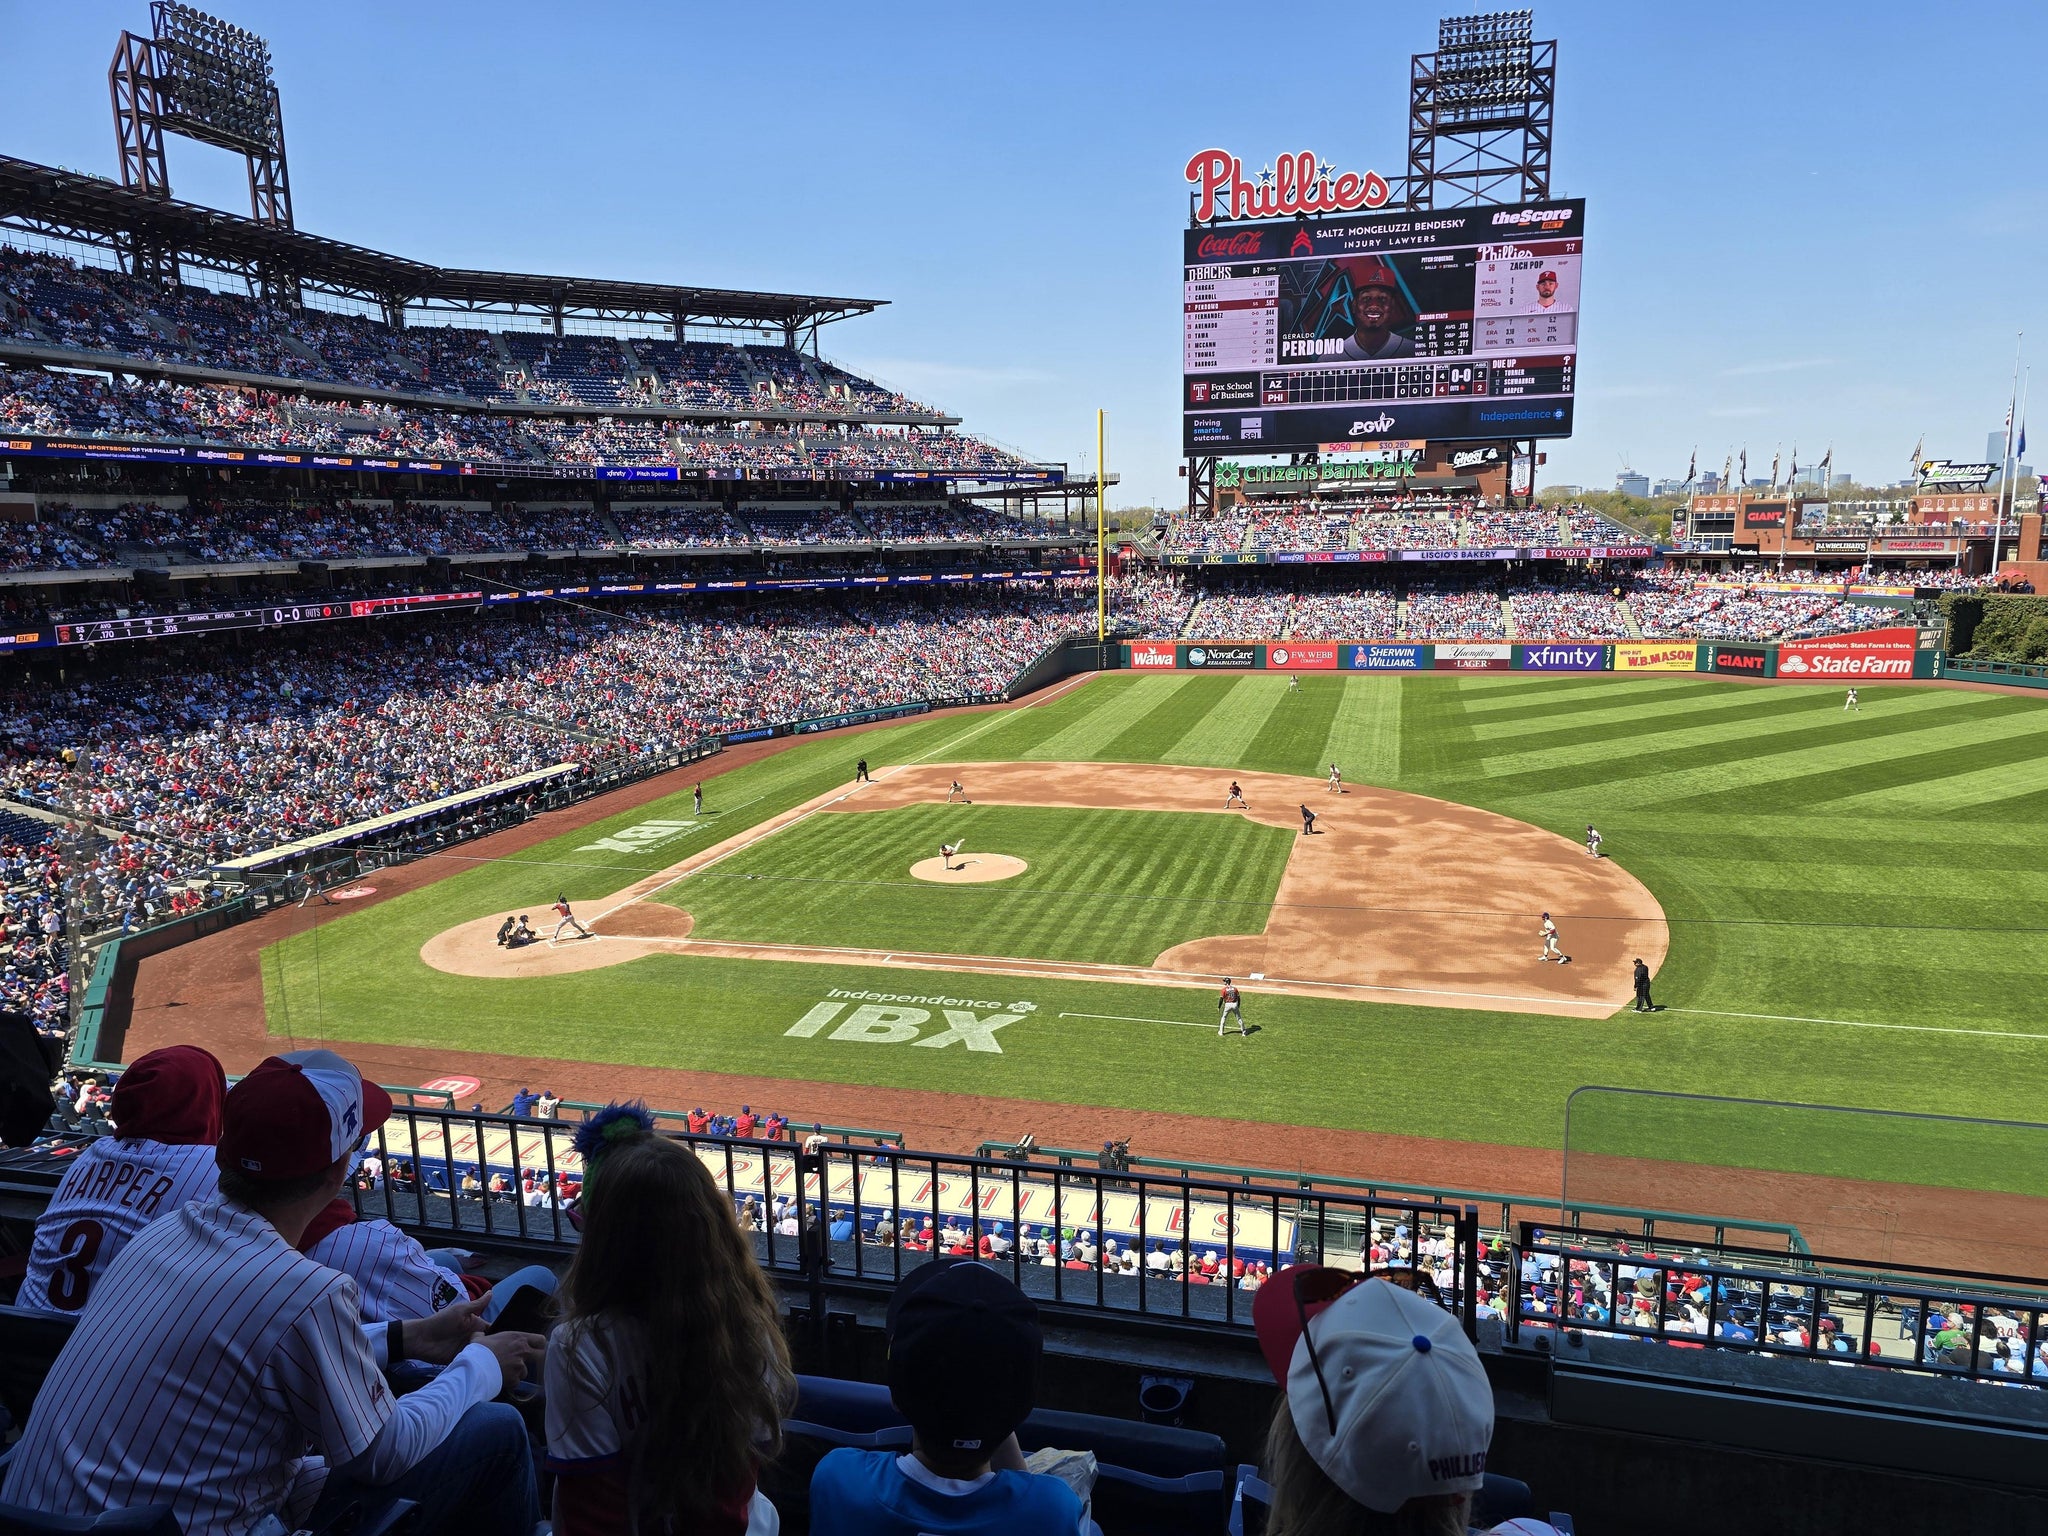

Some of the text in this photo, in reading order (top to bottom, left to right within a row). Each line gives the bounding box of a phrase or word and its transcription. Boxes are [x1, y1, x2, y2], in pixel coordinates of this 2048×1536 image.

[1185, 148, 1390, 222] Phillies
[1492, 208, 1573, 225] theScore
[1316, 219, 1466, 239] SALTZ MONGELUZZI BENDESKY
[1344, 234, 1436, 249] INJURY LAWYERS
[1478, 245, 1533, 261] Phillies
[1510, 262, 1528, 270] ZACH
[1530, 261, 1543, 269] POP
[1282, 332, 1315, 340] GERALDO
[1282, 338, 1344, 357] PERDOMO
[1492, 359, 1517, 369] DUE UP
[1269, 380, 1282, 389] AZ
[1439, 372, 1445, 380] 4
[1451, 368, 1472, 383] 0-0
[1211, 381, 1252, 391] Fox School
[1210, 391, 1254, 400] of Business
[1267, 393, 1284, 402] PHI
[1480, 410, 1551, 422] Independence
[1194, 419, 1221, 428] Driving
[1352, 420, 1391, 434] PGW
[1193, 426, 1222, 434] smarter
[1379, 441, 1410, 450] $30,280
[1453, 448, 1486, 468] GHOST
[1243, 459, 1416, 483] Citizens Bank Park
[1926, 461, 1992, 477] Fitzpatrick
[1748, 512, 1783, 521] GIANT
[1362, 552, 1386, 561] NECA
[1421, 549, 1497, 559] LISCIO'S BAKERY
[1549, 549, 1588, 557] TOYOTA
[1610, 547, 1649, 556] TOYOTA
[1169, 555, 1189, 564] UKG
[1203, 555, 1223, 564] UKG
[1237, 554, 1257, 563] UKG
[1307, 553, 1330, 562] NECA
[76, 626, 85, 634] SS
[79, 633, 84, 641] 2
[163, 625, 178, 633] .305
[1920, 630, 1942, 640] MONTY'S
[17, 634, 38, 642] BET
[1919, 639, 1937, 649] ANGLE
[1207, 649, 1253, 659] NovaCare
[1369, 646, 1415, 657] SHERWIN
[1449, 646, 1497, 658] Yuengling
[1134, 652, 1173, 665] Wawa
[1368, 656, 1416, 667] WILLIAMS.
[1527, 646, 1598, 668] xfinity
[1716, 654, 1765, 669] GIANT
[1457, 660, 1488, 668] LAGER
[728, 729, 767, 742] Independence
[826, 988, 1002, 1010] Independence
[783, 1001, 1028, 1054] IBX
[58, 1159, 174, 1215] HARPER
[47, 1218, 104, 1312] 3
